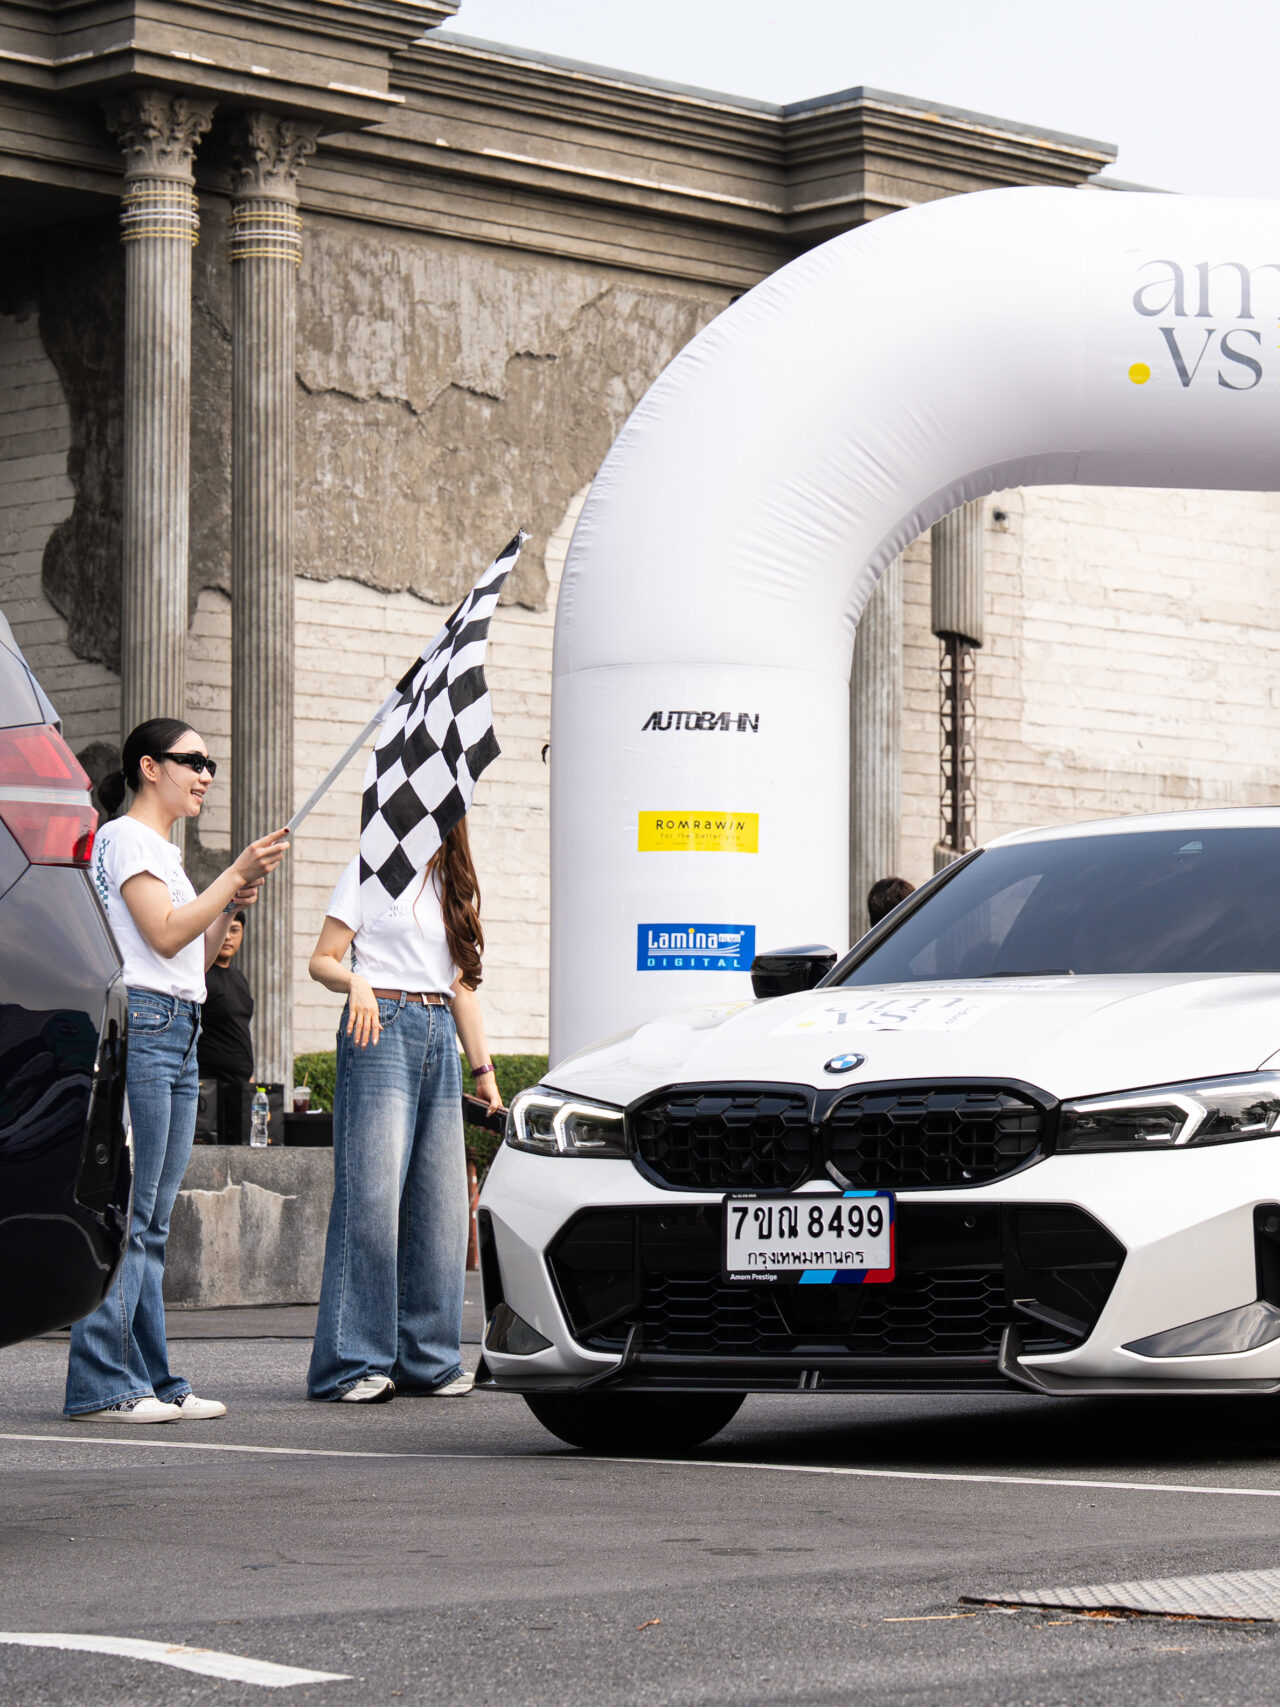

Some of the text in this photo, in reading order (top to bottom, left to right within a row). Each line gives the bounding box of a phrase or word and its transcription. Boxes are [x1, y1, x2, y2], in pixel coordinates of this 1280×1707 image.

[641, 710, 760, 733] AUTOBAHN
[647, 928, 719, 949] Lamina
[647, 957, 741, 968] DIGITAL
[731, 1204, 884, 1240] 7ขณ 8499
[747, 1250, 865, 1270] กรุงเทพมหานคร
